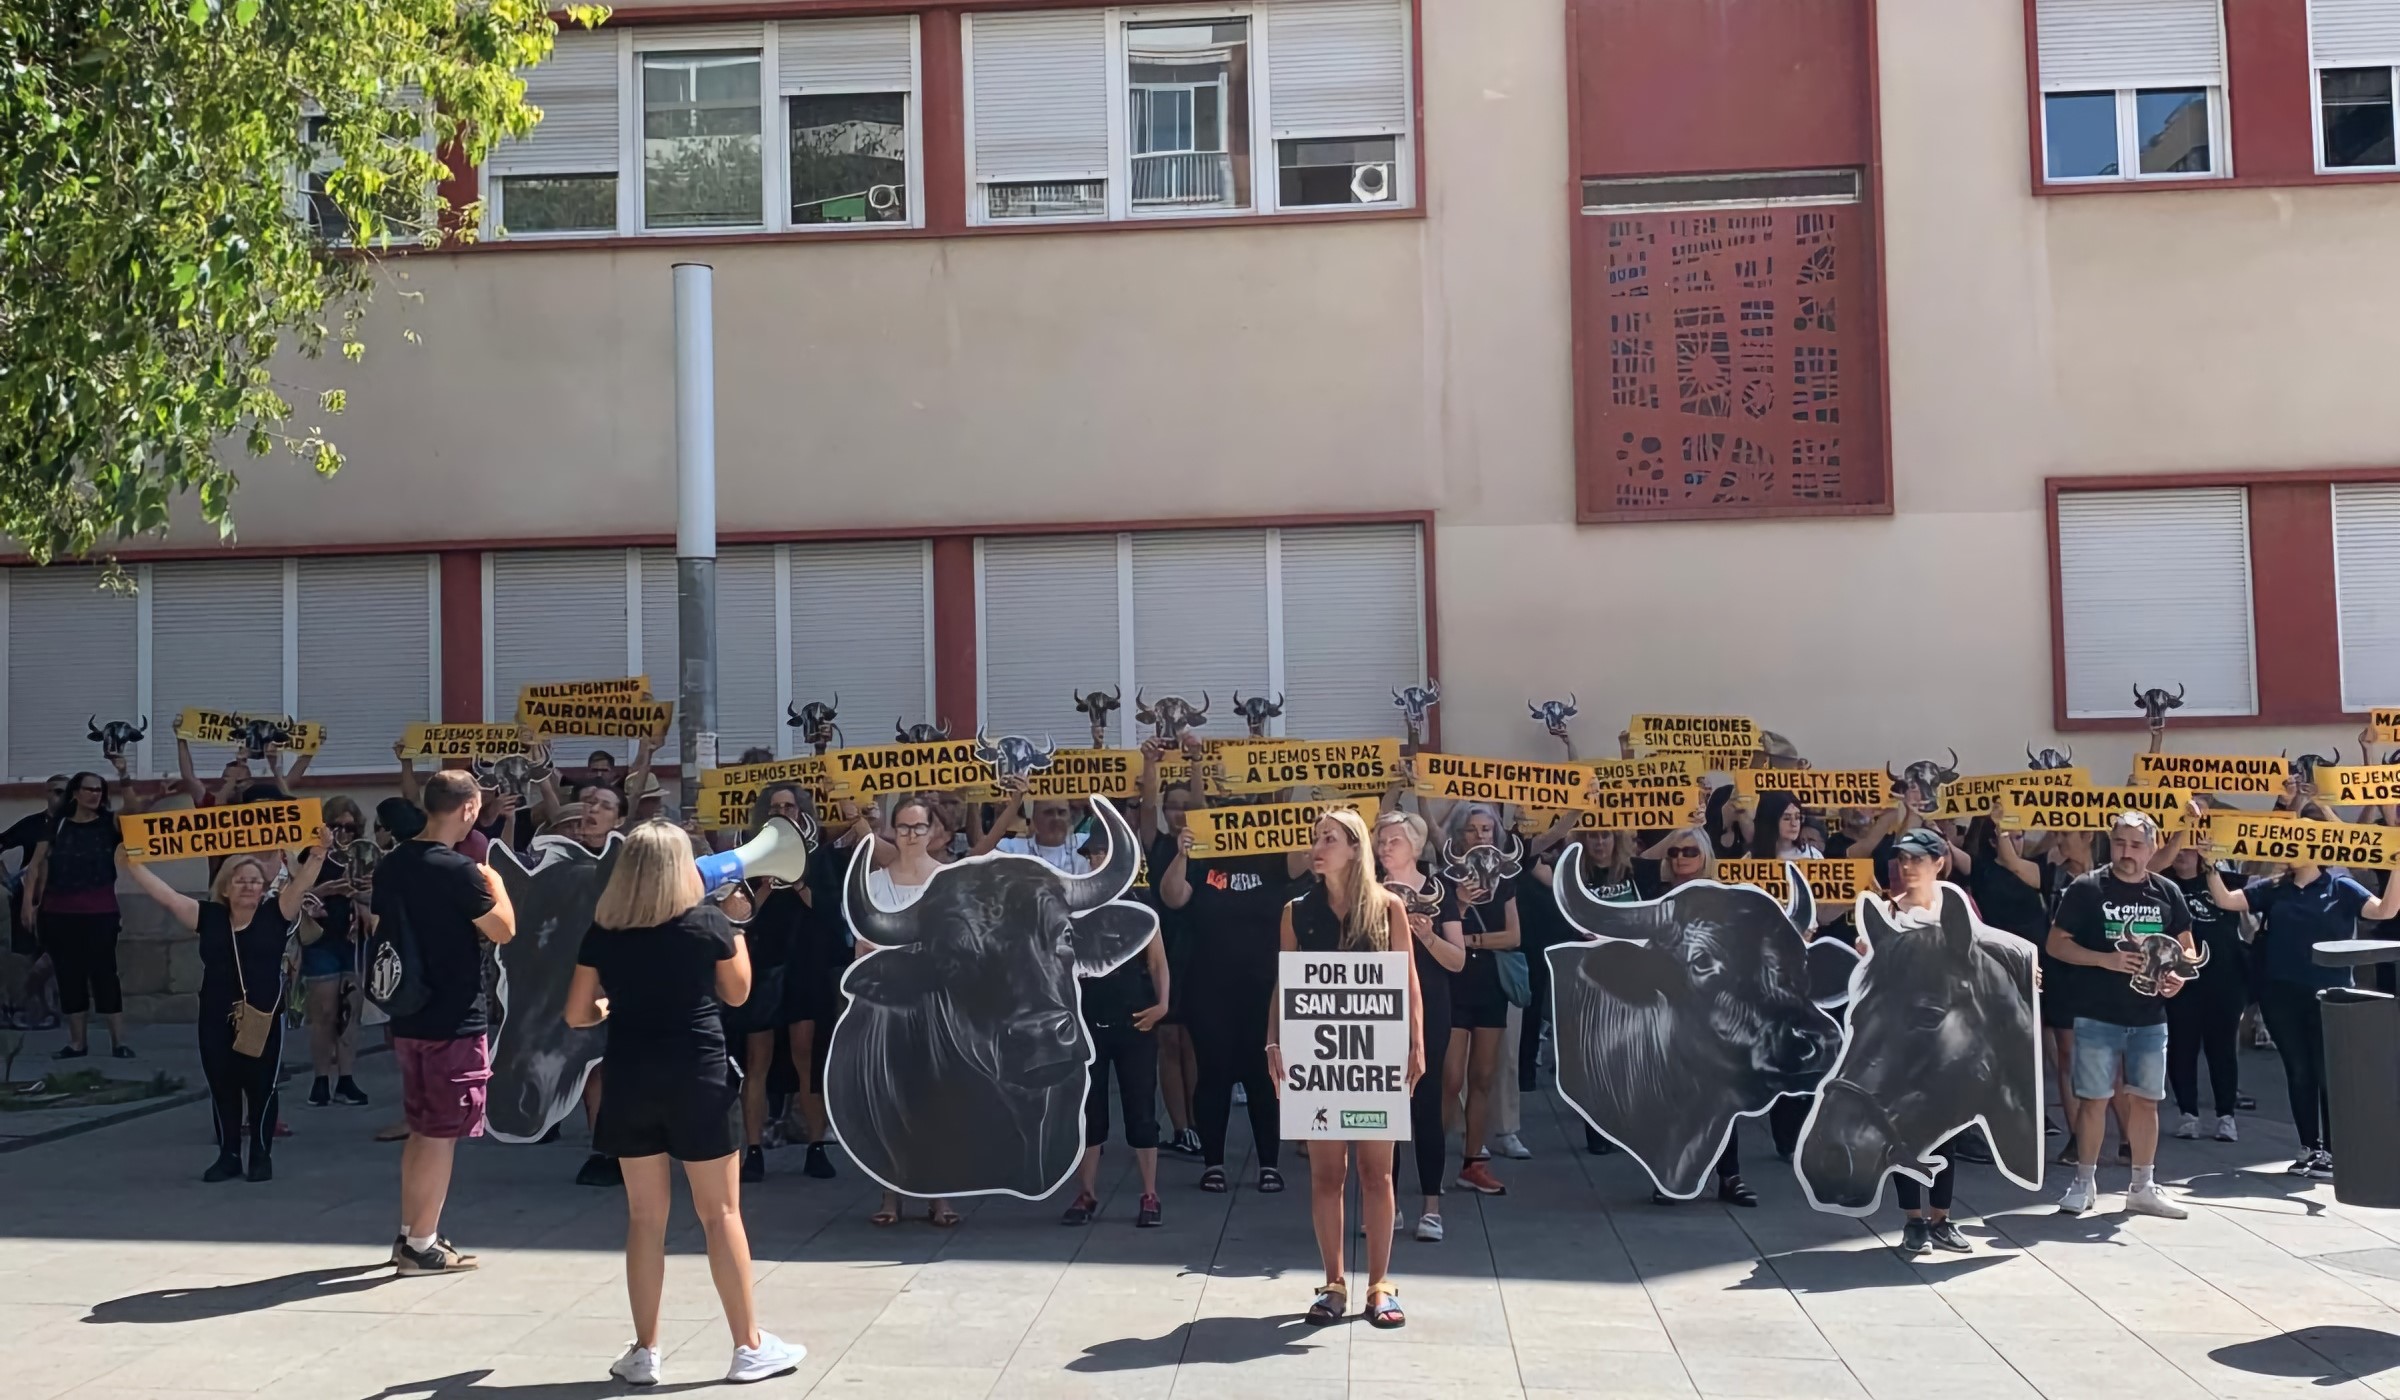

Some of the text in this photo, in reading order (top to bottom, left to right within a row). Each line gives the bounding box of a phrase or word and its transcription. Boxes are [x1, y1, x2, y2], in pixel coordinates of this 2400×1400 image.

[530, 680, 640, 698] BULLFIGHTING
[525, 701, 665, 720] TAUROMAQUIA
[198, 726, 222, 740] SIN
[424, 728, 483, 740] DEJEMOS
[486, 728, 503, 739] EN
[1642, 717, 1751, 732] TRADICIONES
[420, 741, 432, 754] A
[439, 741, 470, 754] LOS
[1644, 732, 1752, 747] SIN CRUELDAD
[1248, 744, 1381, 766] DEJEMOS EN PAZ
[724, 765, 786, 786] DEJEMOS
[790, 763, 807, 777] EN
[810, 761, 827, 774] PA
[1246, 761, 1384, 783] A LOS TOROS
[1429, 758, 1581, 786] BULLFIGHTING
[1638, 762, 1656, 776] EN
[1661, 760, 1686, 774] PAZ
[2141, 757, 2281, 775] TAUROMAQUIA
[1754, 772, 1880, 788] CRUELTY FREE
[1445, 780, 1568, 804] ABOLITION
[1599, 791, 1685, 808] IGHTING
[2010, 790, 2178, 809] TAUROMAQUIA
[2340, 787, 2355, 800] A
[1945, 799, 1959, 814] A
[143, 805, 301, 835] TRADICIONES
[2030, 811, 2164, 828] ABOLICN
[148, 824, 302, 856] SIN CRUELDAD
[1214, 831, 1247, 851] SIN
[2237, 823, 2383, 846] DEJEMOS EN PAZ
[2232, 840, 2383, 864] A LOS TOROS
[1808, 863, 1855, 880] FREE
[1304, 963, 1384, 984] POR UN
[1294, 993, 1394, 1014] SAN JUAN
[1313, 1024, 1374, 1060] SIN
[1288, 1064, 1402, 1092] SANGRE
